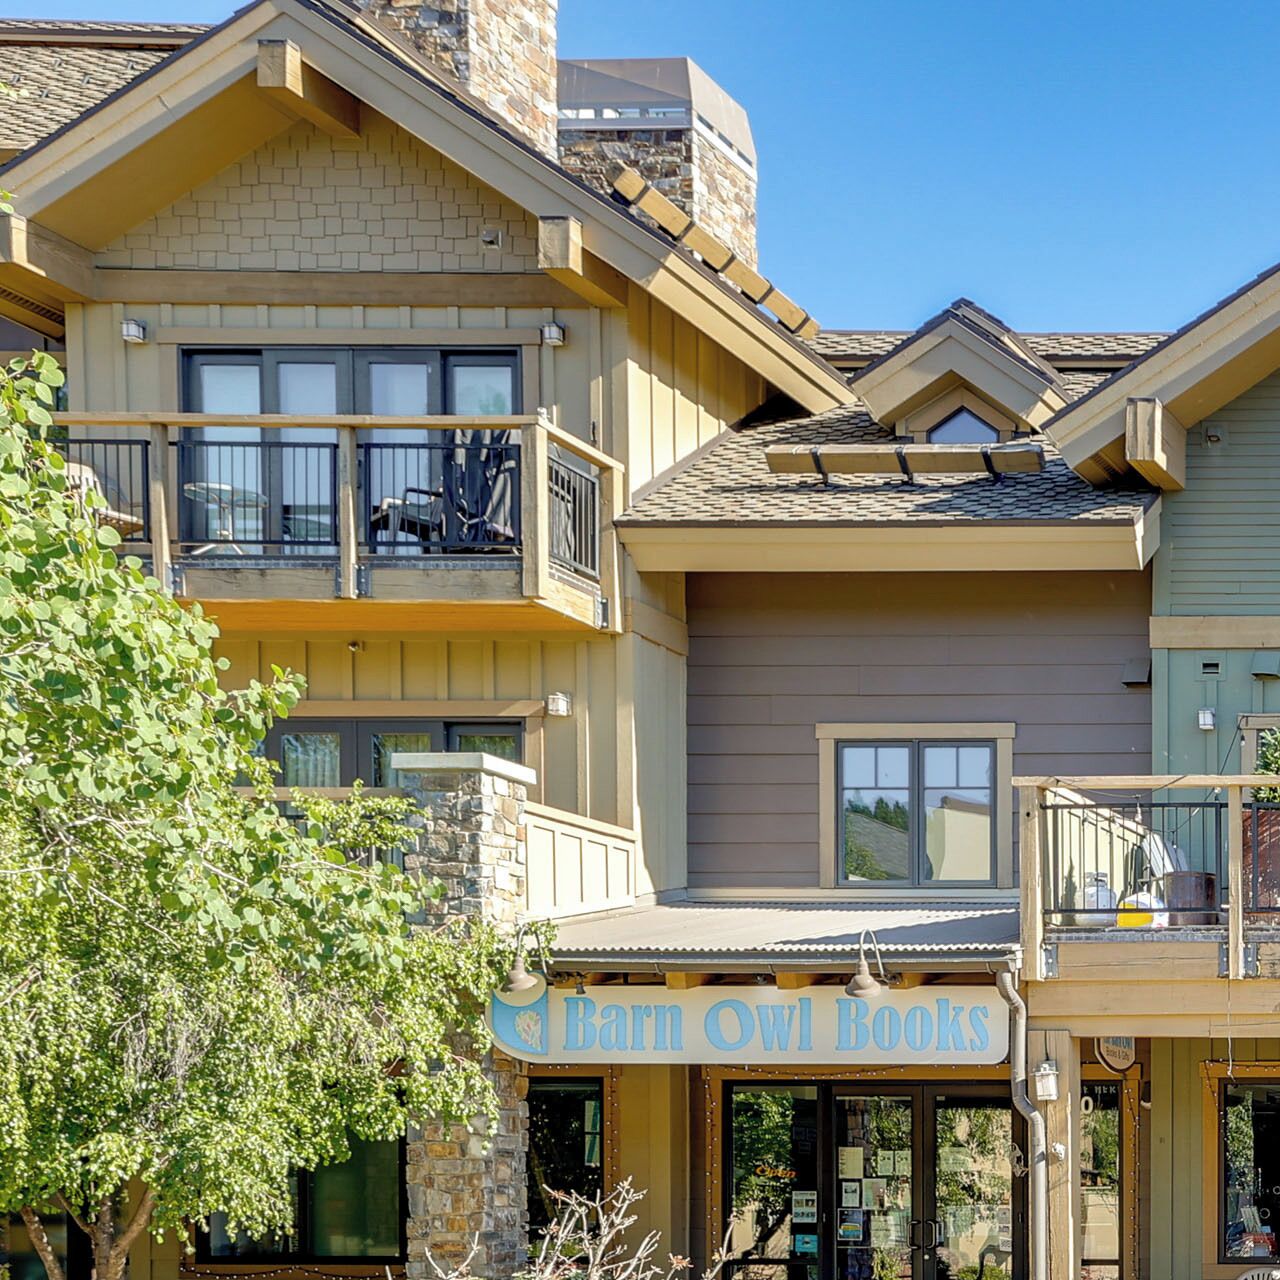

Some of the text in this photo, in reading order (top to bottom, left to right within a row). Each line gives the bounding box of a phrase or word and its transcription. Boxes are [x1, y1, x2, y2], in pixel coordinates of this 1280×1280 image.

[563, 996, 990, 1051] Barn Owl Books
